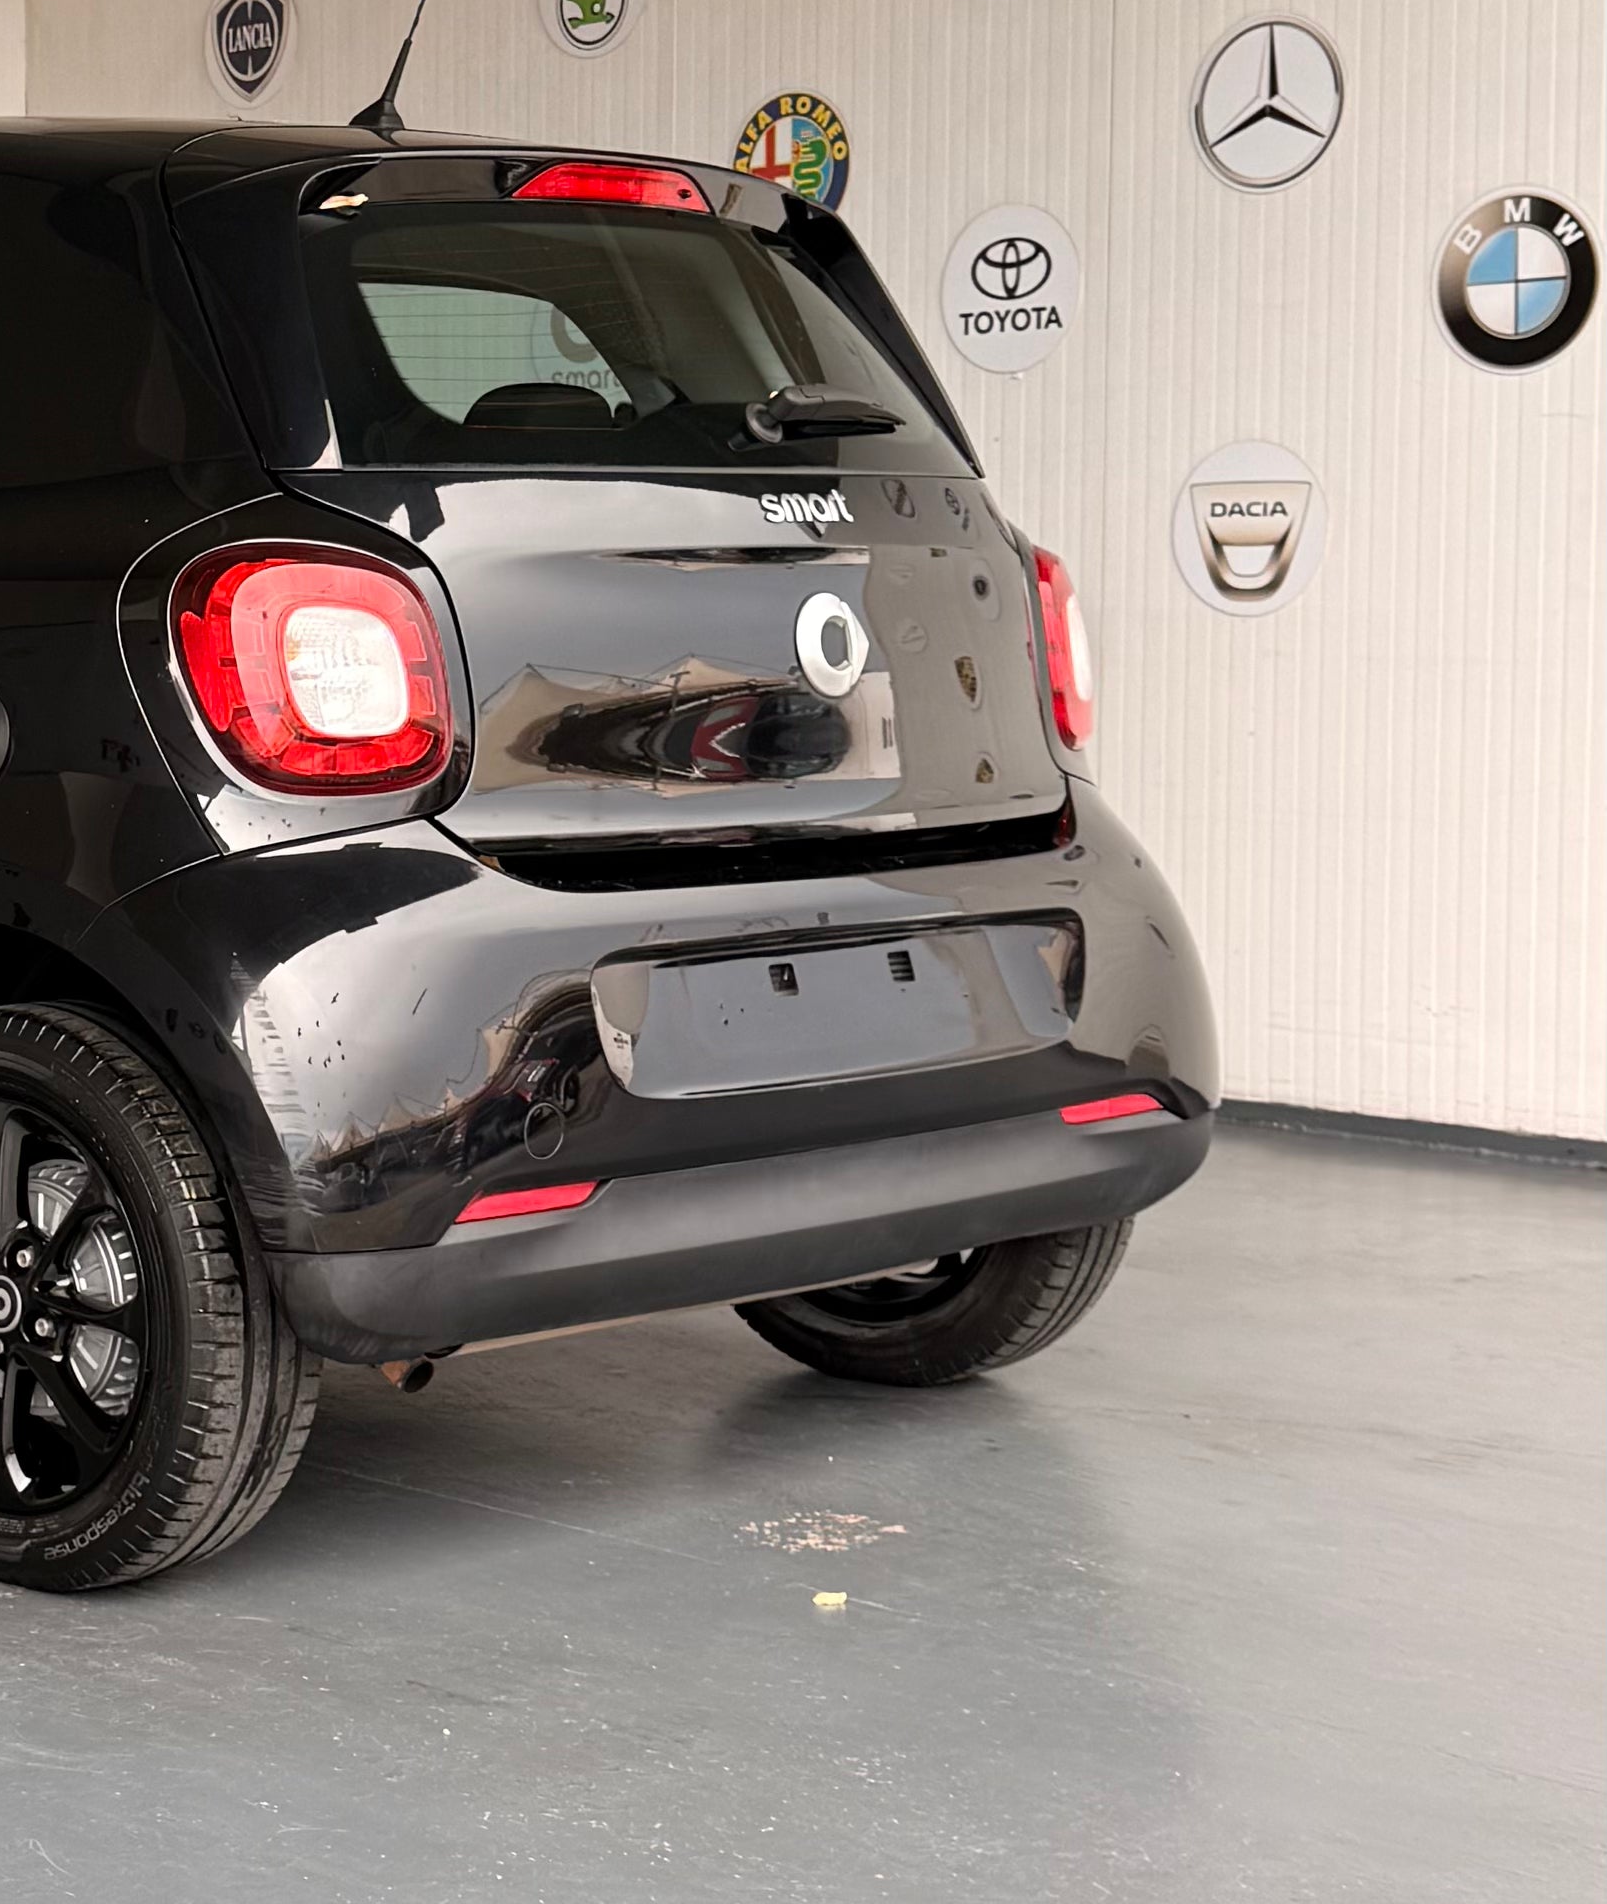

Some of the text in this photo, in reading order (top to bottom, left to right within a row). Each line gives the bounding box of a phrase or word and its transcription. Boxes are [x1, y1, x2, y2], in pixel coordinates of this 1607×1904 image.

[228, 23, 274, 54] LANCIA
[734, 95, 848, 173] ALFA ROMEO
[1453, 199, 1586, 254] BMW
[959, 306, 1063, 338] TOYOTA
[761, 489, 854, 523] smart
[1210, 497, 1290, 522] DACIA
